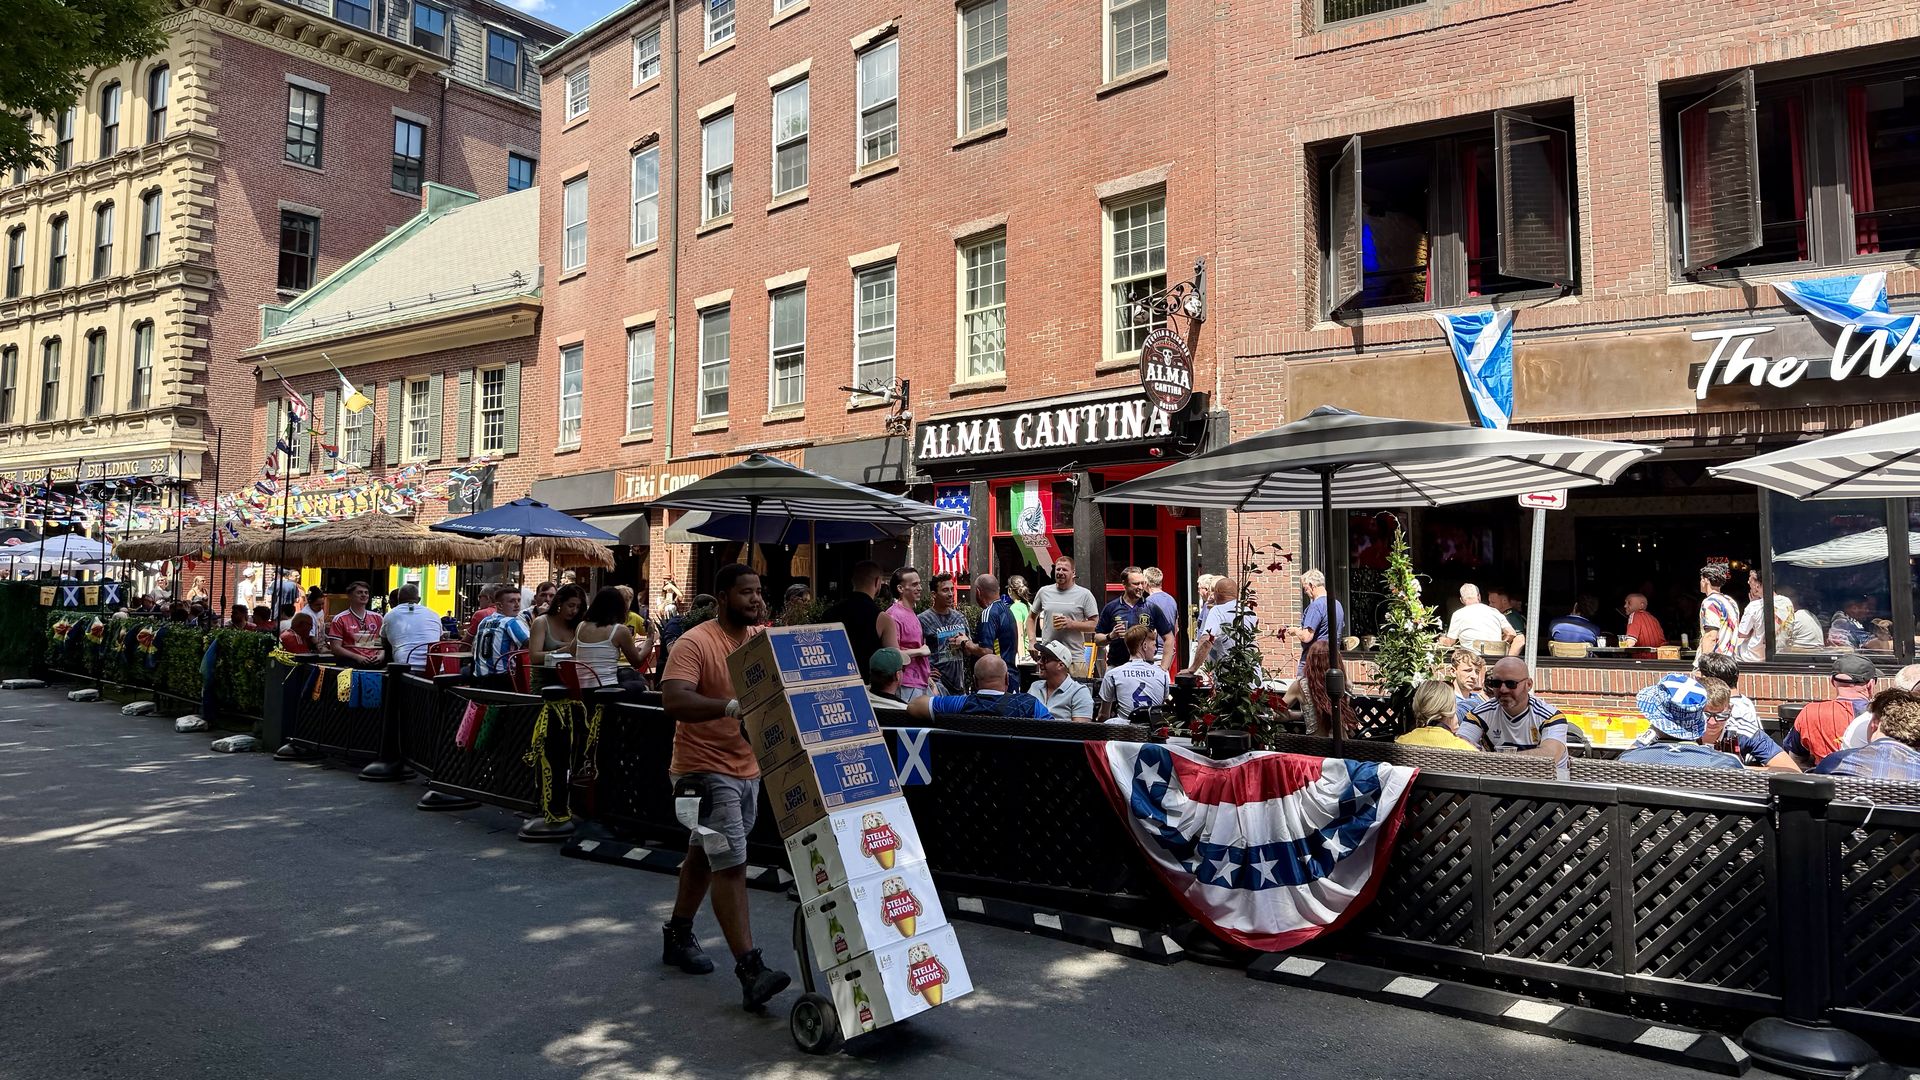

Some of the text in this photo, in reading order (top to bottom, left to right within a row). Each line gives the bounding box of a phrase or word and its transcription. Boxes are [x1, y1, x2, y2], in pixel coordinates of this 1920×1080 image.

[1691, 314, 1920, 400] The W
[1145, 362, 1190, 390] ALMA
[1154, 382, 1182, 396] CANTINA
[918, 399, 1173, 460] ALMA CANTINA
[149, 457, 165, 473] 33
[625, 474, 656, 498] Tiki
[936, 623, 965, 634] ARIZONA
[801, 645, 825, 657] BUD
[799, 654, 832, 667] LIGHT
[745, 663, 762, 679] BUD
[745, 669, 766, 689] LIGHT
[1122, 670, 1156, 678] TIERNEY
[1132, 682, 1153, 709] 6
[820, 702, 846, 715] BUD
[819, 711, 852, 726] LIGHT
[764, 724, 780, 740] BUD
[764, 730, 785, 750] LIGHT
[842, 762, 867, 777] BUD
[841, 771, 874, 788] LIGHT
[785, 785, 802, 801] BUD
[784, 791, 807, 812] LIGHT
[866, 830, 892, 842] STELLA
[868, 837, 894, 850] ARTOIS
[886, 895, 912, 910] STELLA
[889, 903, 914, 918] ARTOIS
[912, 962, 938, 978] STELLA
[915, 970, 941, 987] ARTOIS
